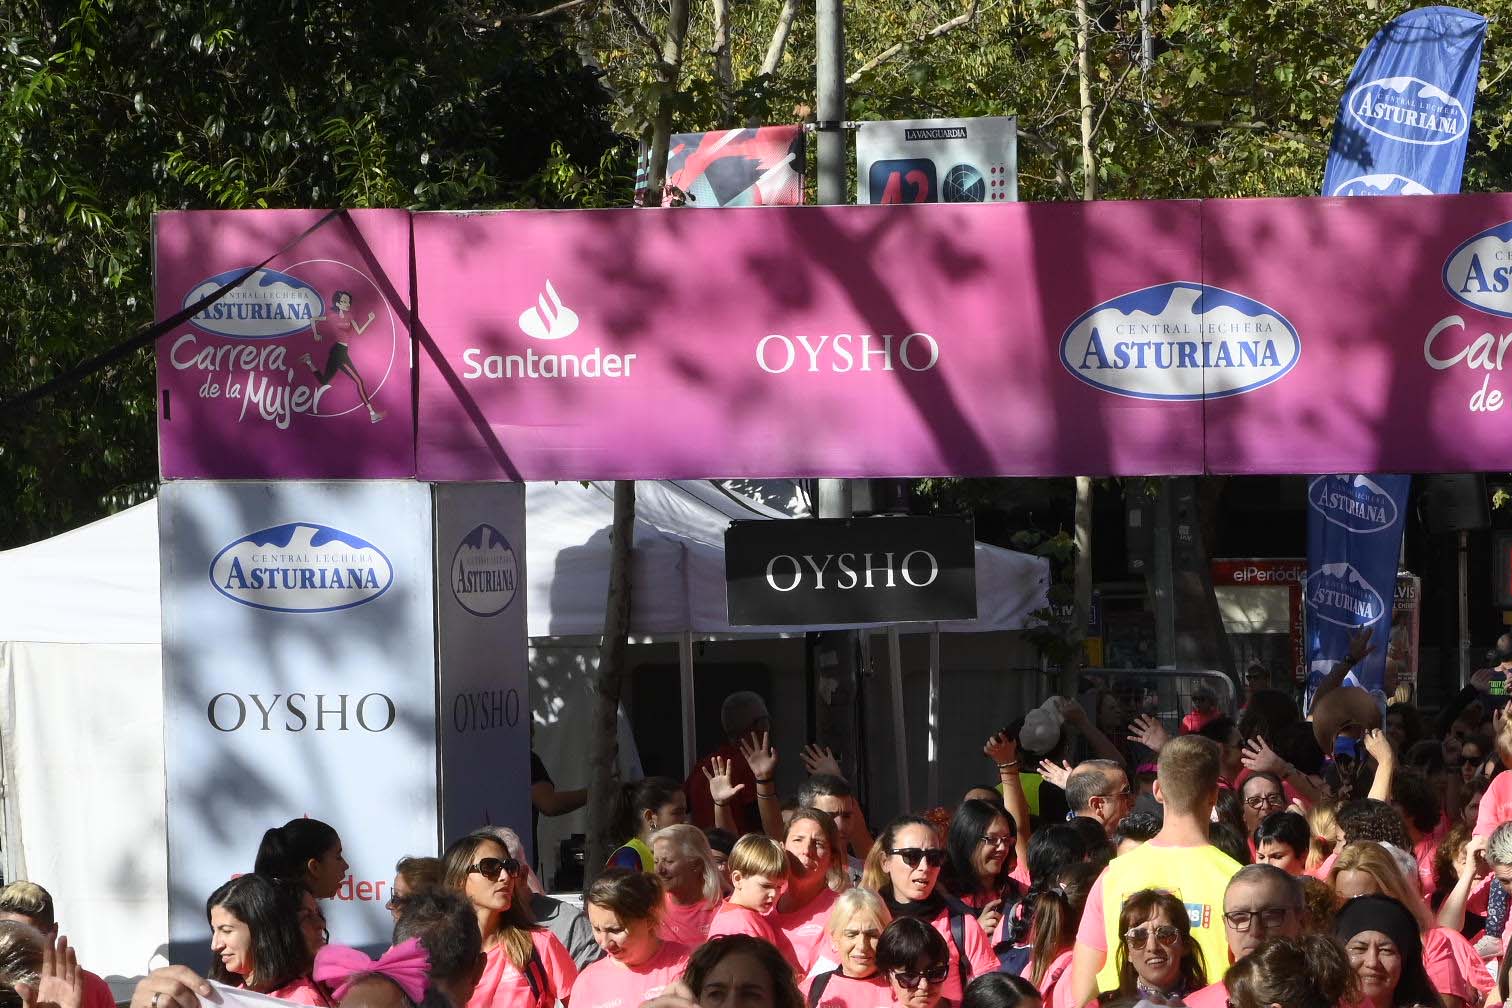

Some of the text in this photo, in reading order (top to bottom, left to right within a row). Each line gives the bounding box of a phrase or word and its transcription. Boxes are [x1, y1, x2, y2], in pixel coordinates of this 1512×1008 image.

[1357, 92, 1457, 135] ASTURIANA
[1078, 326, 1282, 370] ASTURIANA
[1116, 321, 1274, 334] CENTRAL LECHERA
[171, 333, 287, 371] Carrera
[463, 348, 637, 379] Santander
[755, 332, 940, 374] OYSHO
[200, 368, 332, 430] de la Mujer
[1469, 372, 1504, 412] de
[1317, 482, 1387, 524] ASTURIANA
[223, 556, 380, 590] ASTURIANA
[252, 553, 373, 564] CENTRAL LECHERA
[456, 559, 514, 594] ASTURIANA
[765, 549, 939, 592] OYSHO
[207, 692, 396, 733] OYSHO
[453, 688, 520, 734] OYSHO
